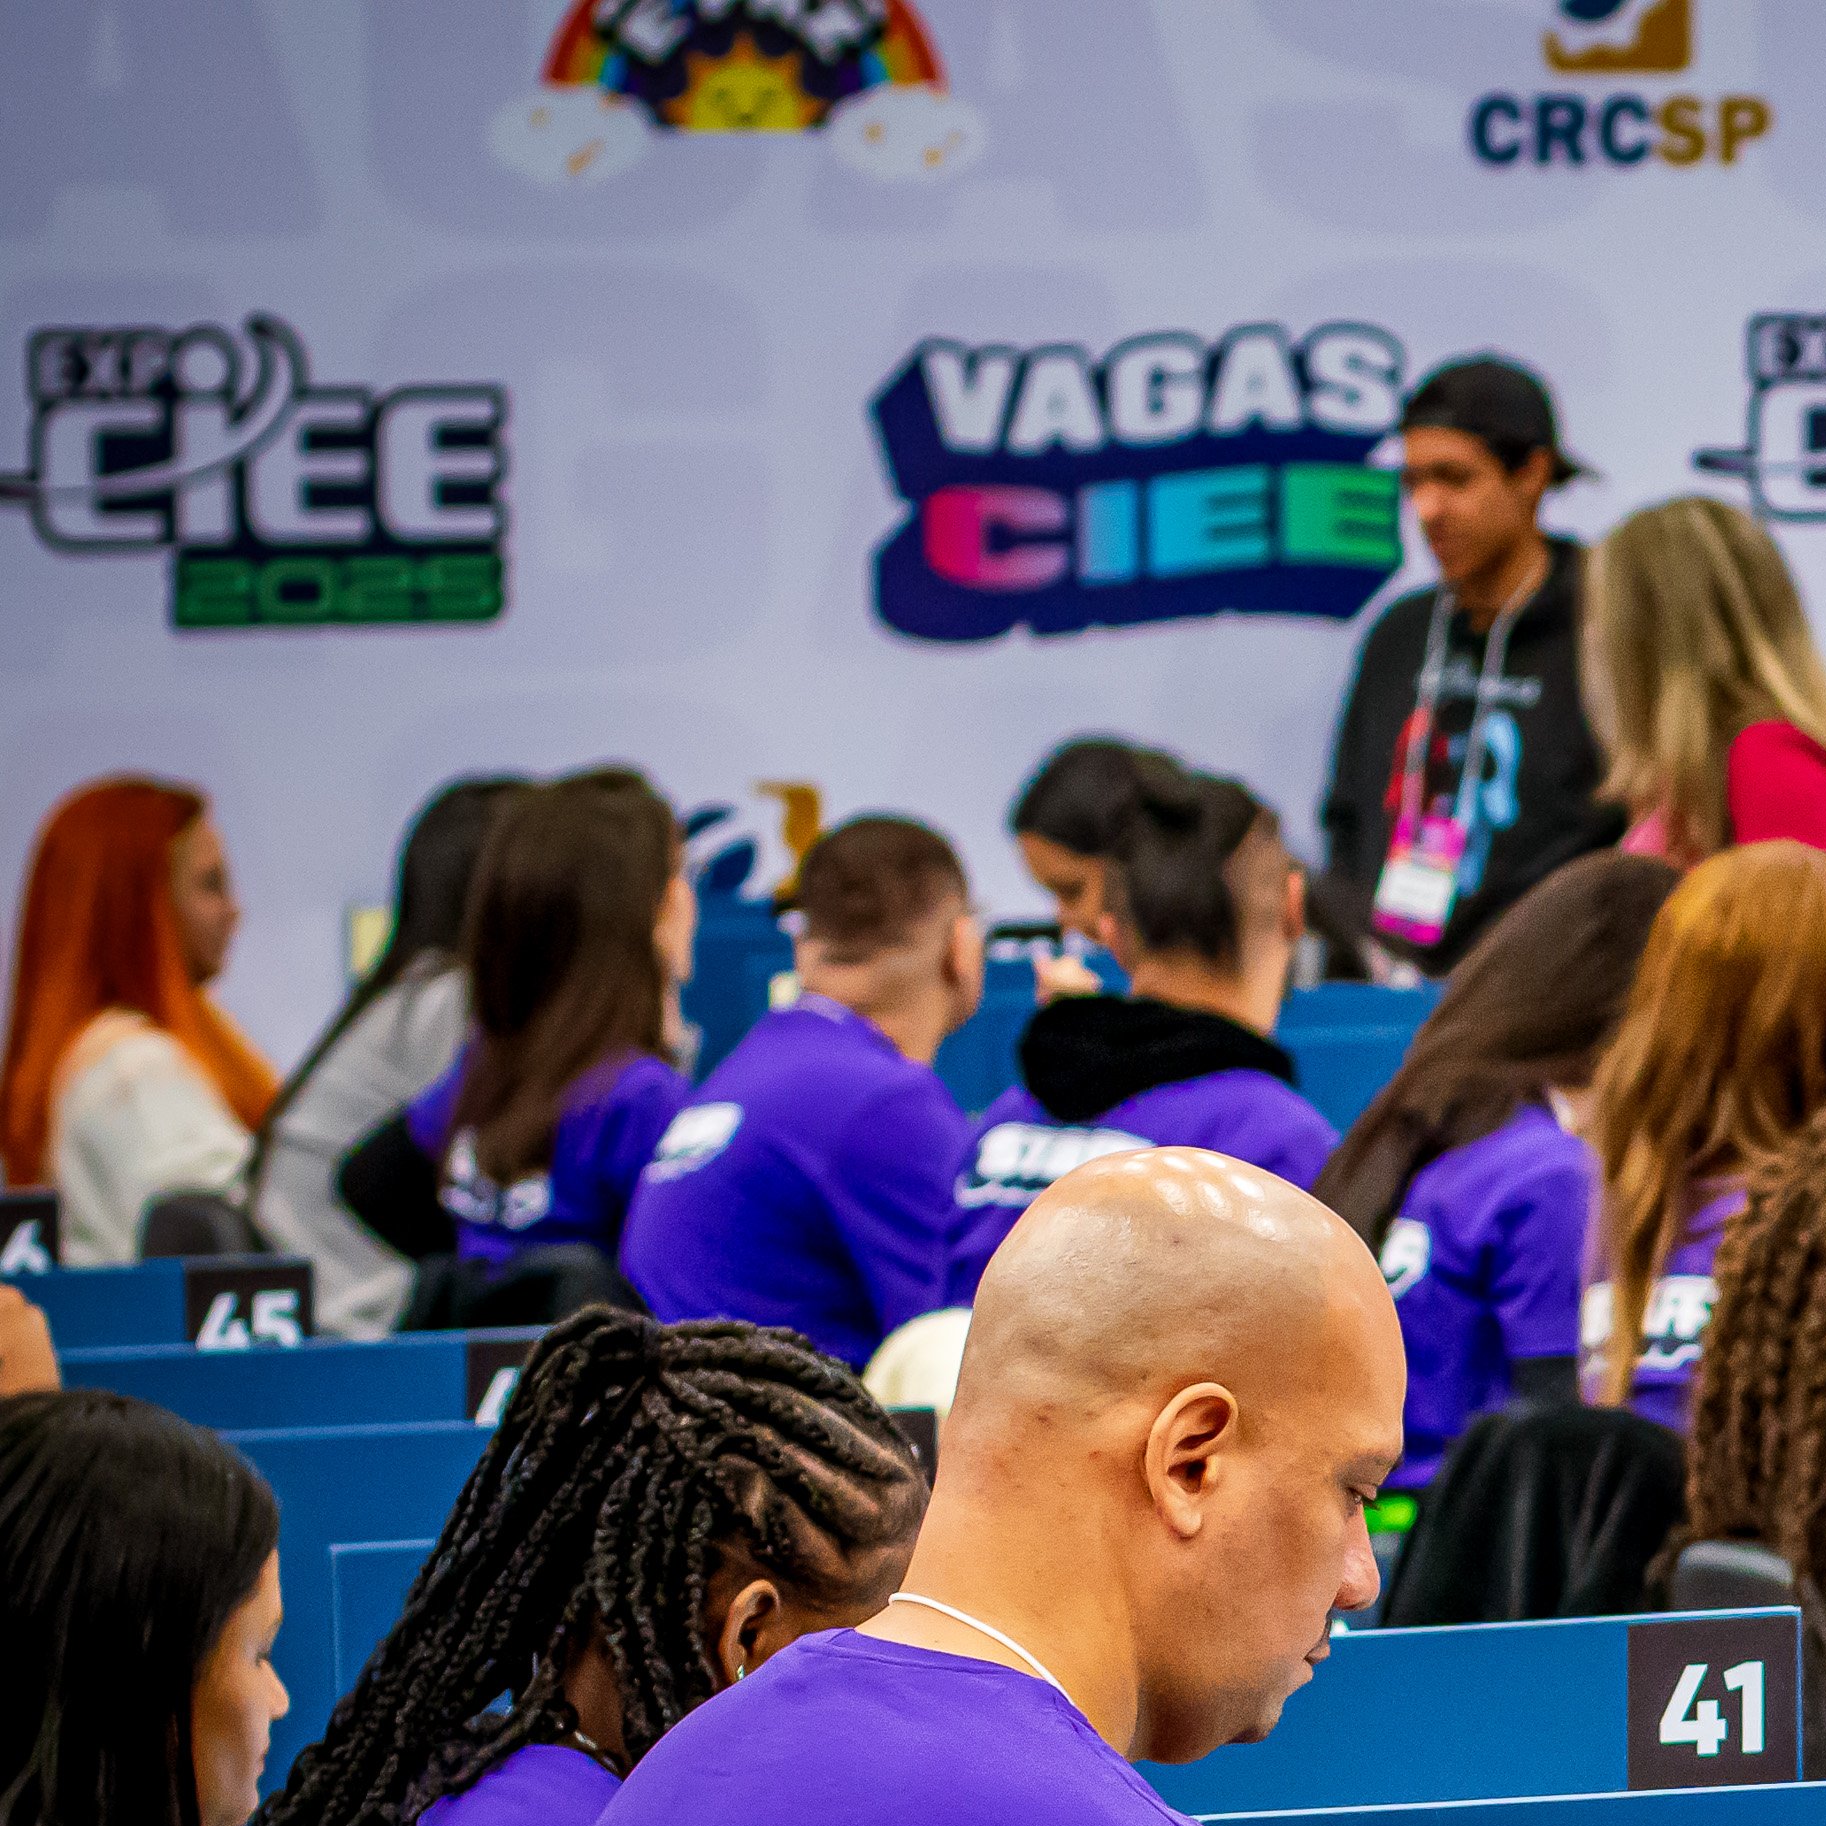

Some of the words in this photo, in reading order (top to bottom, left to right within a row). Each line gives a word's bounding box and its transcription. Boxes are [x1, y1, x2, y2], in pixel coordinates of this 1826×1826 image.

[1470, 95, 1773, 167] CRCSP
[924, 331, 1401, 453] VAGAS
[42, 400, 500, 544] CIEE
[922, 461, 1401, 591] CIEE
[195, 1288, 301, 1351] 45
[1659, 1660, 1766, 1758] 41
